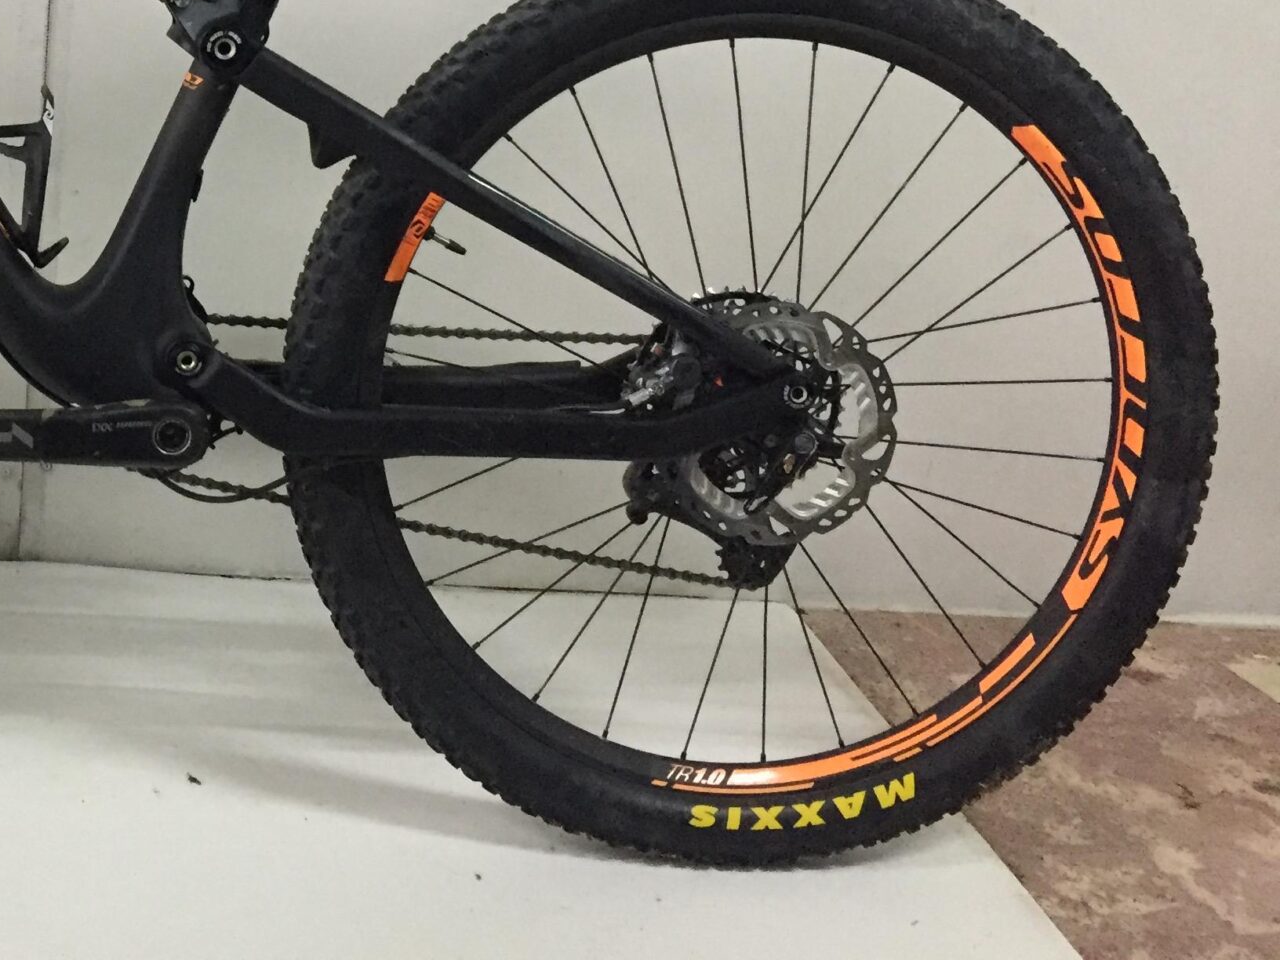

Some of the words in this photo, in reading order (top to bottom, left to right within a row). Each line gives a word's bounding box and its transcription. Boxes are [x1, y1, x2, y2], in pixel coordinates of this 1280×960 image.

[1032, 152, 1148, 588] SYNCROS
[665, 763, 727, 786] TR1.0
[690, 773, 916, 831] MAXXIS
